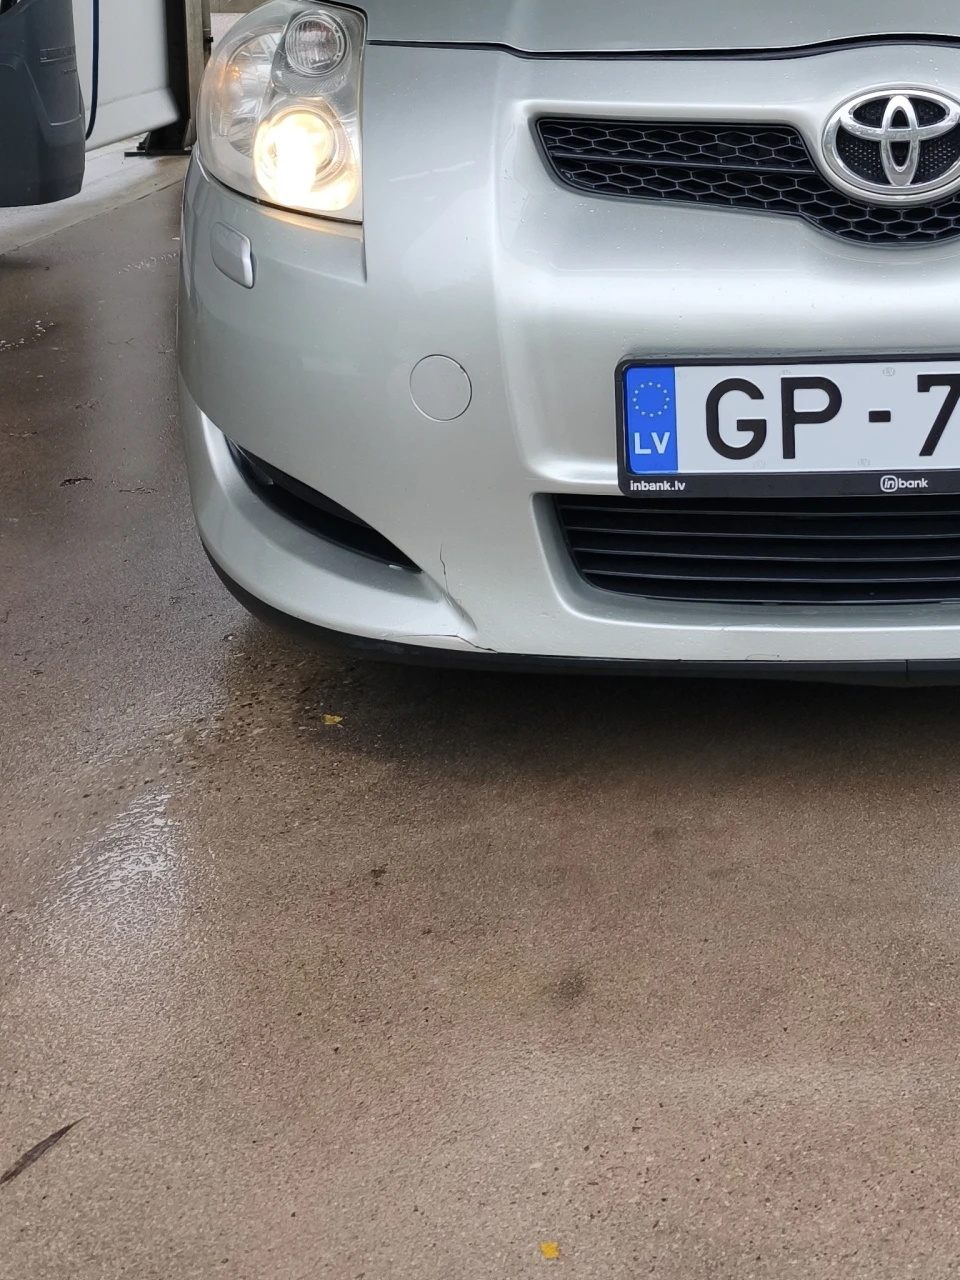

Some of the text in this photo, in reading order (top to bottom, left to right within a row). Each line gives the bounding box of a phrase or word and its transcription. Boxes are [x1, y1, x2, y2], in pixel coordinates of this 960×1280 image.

[633, 431, 671, 455] LV
[629, 480, 686, 491] inbank.lv
[880, 475, 929, 492] inbank
